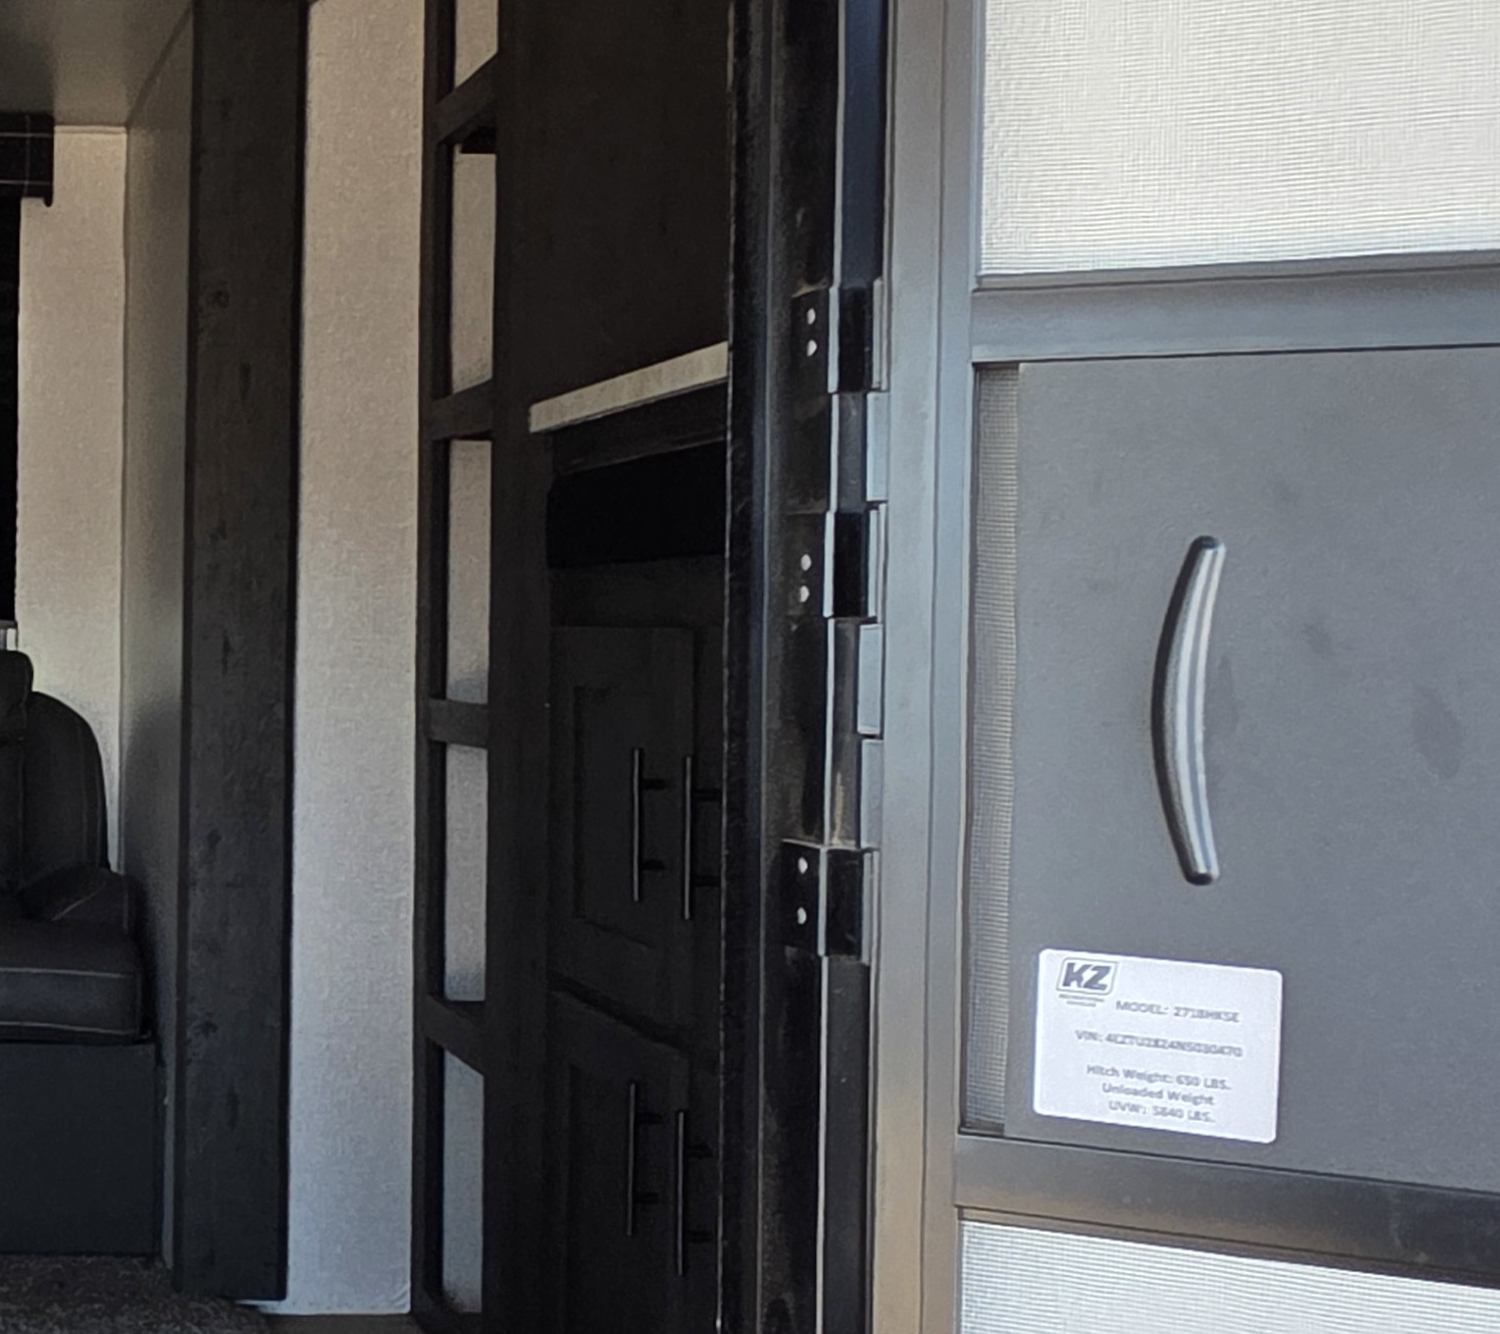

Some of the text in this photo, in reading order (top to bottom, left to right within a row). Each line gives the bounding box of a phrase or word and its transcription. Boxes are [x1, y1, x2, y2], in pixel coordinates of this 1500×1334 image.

[1062, 962, 1112, 991] KZ
[1116, 1000, 1169, 1015] MODEL:
[1075, 1029, 1102, 1042] VIN:
[1086, 1064, 1120, 1078] Hitch
[1123, 1068, 1174, 1084] Weight:
[1102, 1082, 1215, 1106] Unloaded Weight
